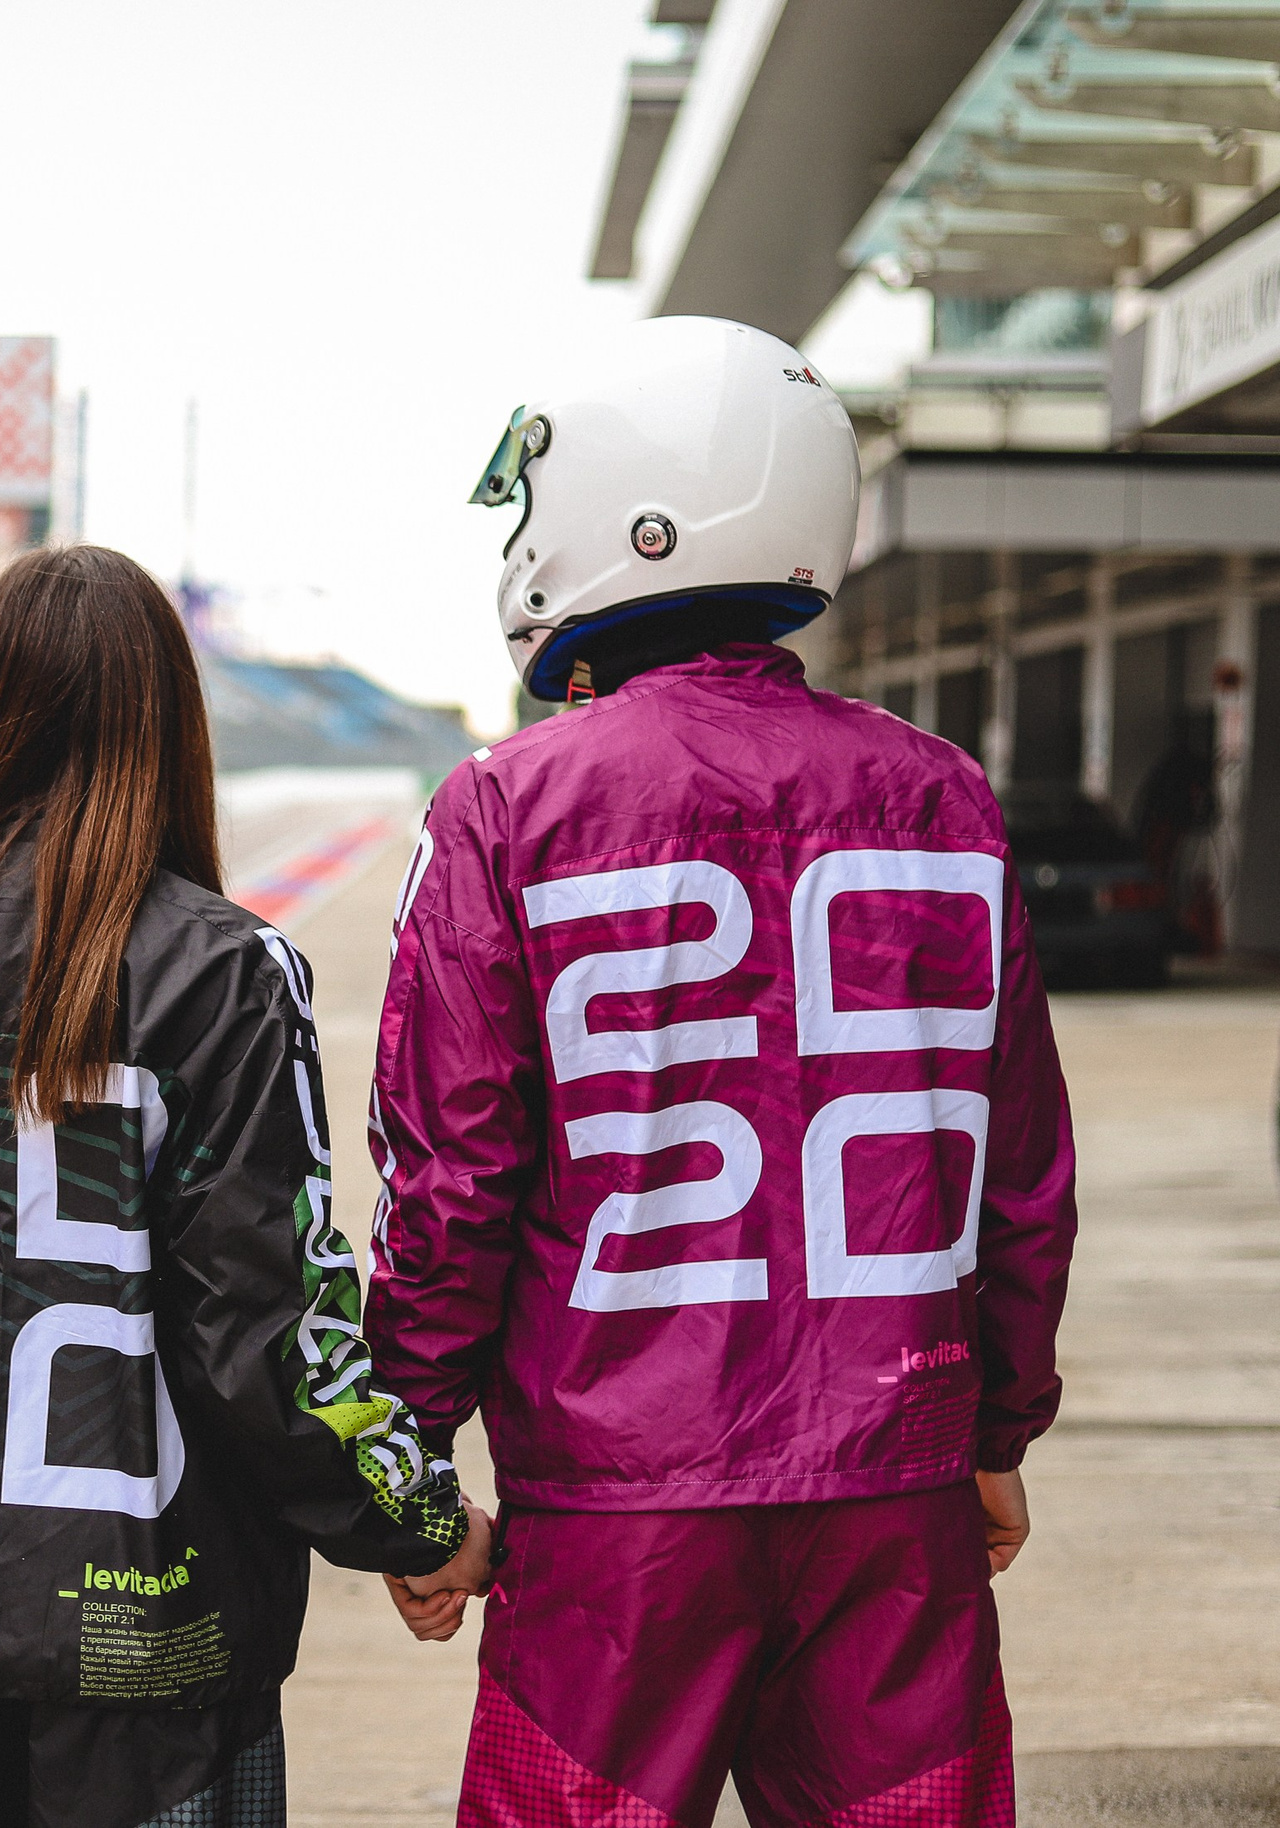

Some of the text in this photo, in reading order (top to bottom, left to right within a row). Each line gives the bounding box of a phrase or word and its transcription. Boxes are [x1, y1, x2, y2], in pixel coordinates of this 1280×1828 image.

[522, 849, 1005, 1085] 20
[565, 1088, 990, 1313] 20
[82, 1601, 147, 1616] COLLECTION:
[81, 1613, 135, 1625] SPORT 2.1
[81, 1625, 102, 1634] Наша
[146, 1640, 152, 1648] В
[80, 1645, 94, 1653] Все
[95, 1646, 128, 1656] барьеры
